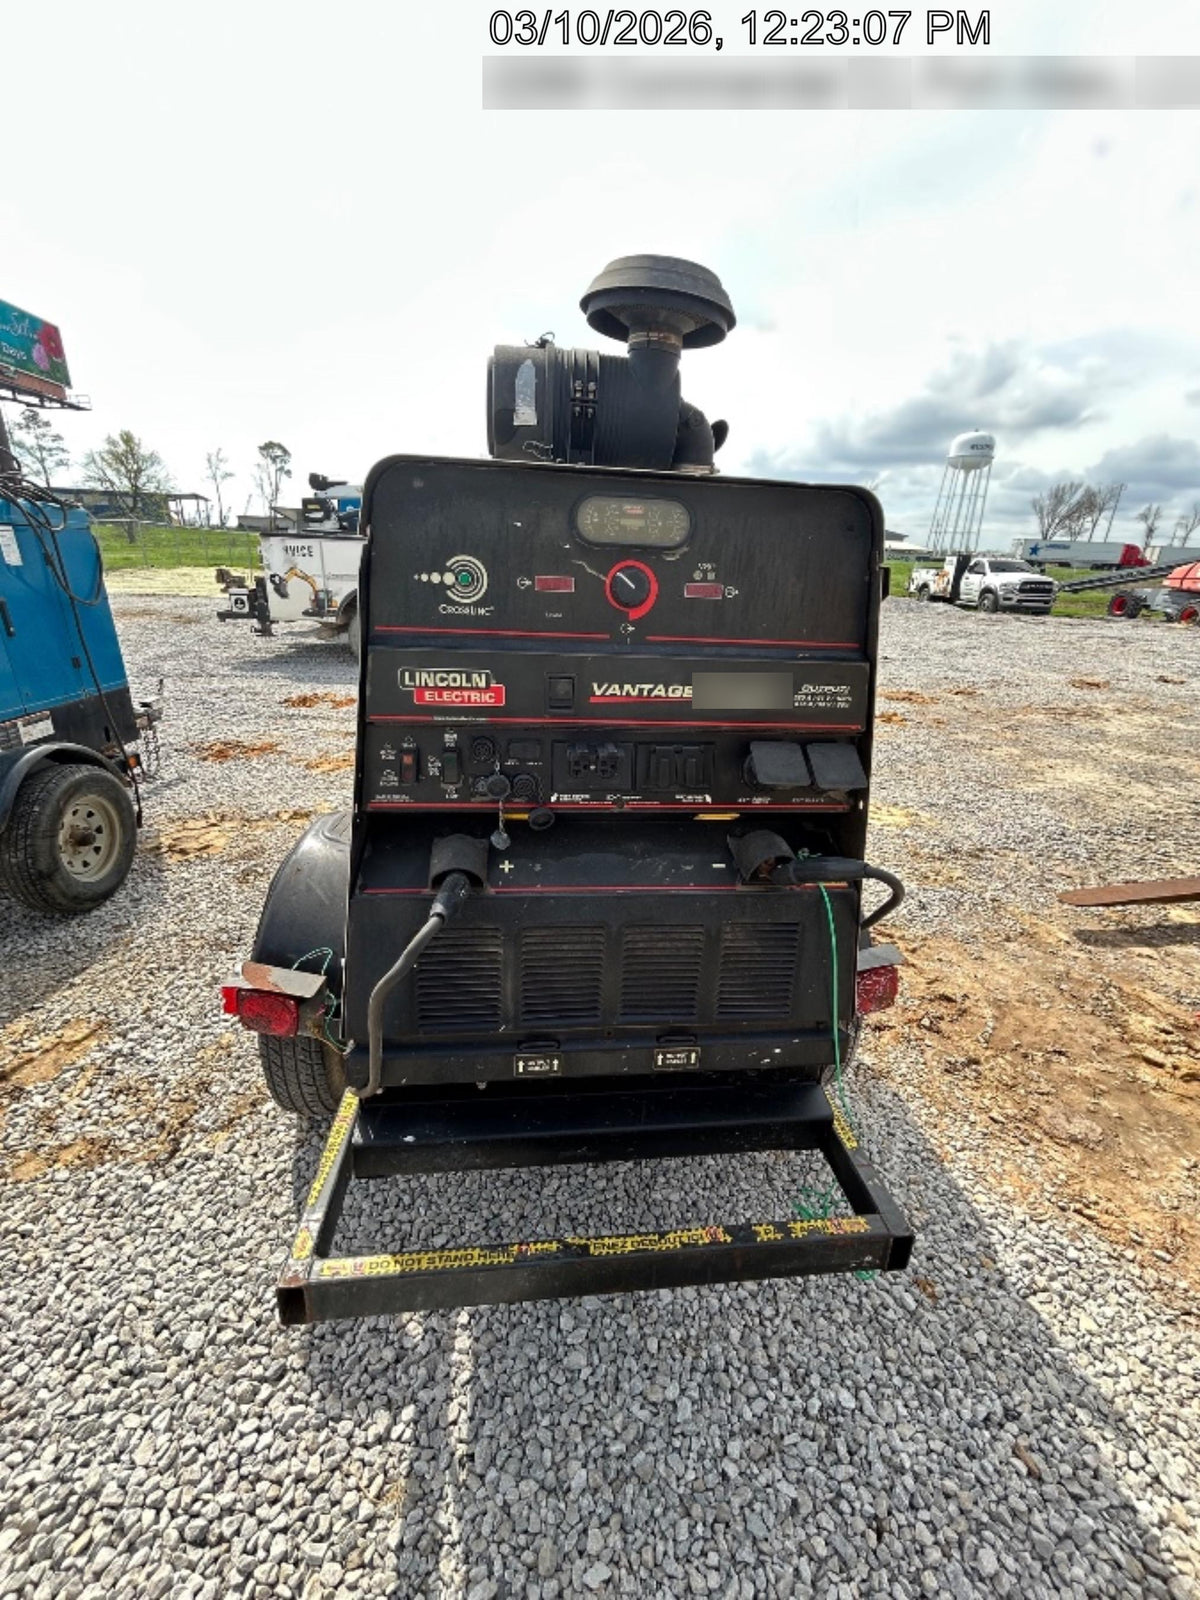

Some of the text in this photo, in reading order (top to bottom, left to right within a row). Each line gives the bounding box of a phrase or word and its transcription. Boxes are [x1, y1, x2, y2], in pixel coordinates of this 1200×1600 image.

[404, 671, 487, 688] LINCOLN
[423, 690, 496, 704] ELECTRIC
[592, 682, 693, 698] VANTAGE
[369, 1260, 392, 1270] DO
[393, 1256, 422, 1268] NOT
[426, 1252, 474, 1265] STAND
